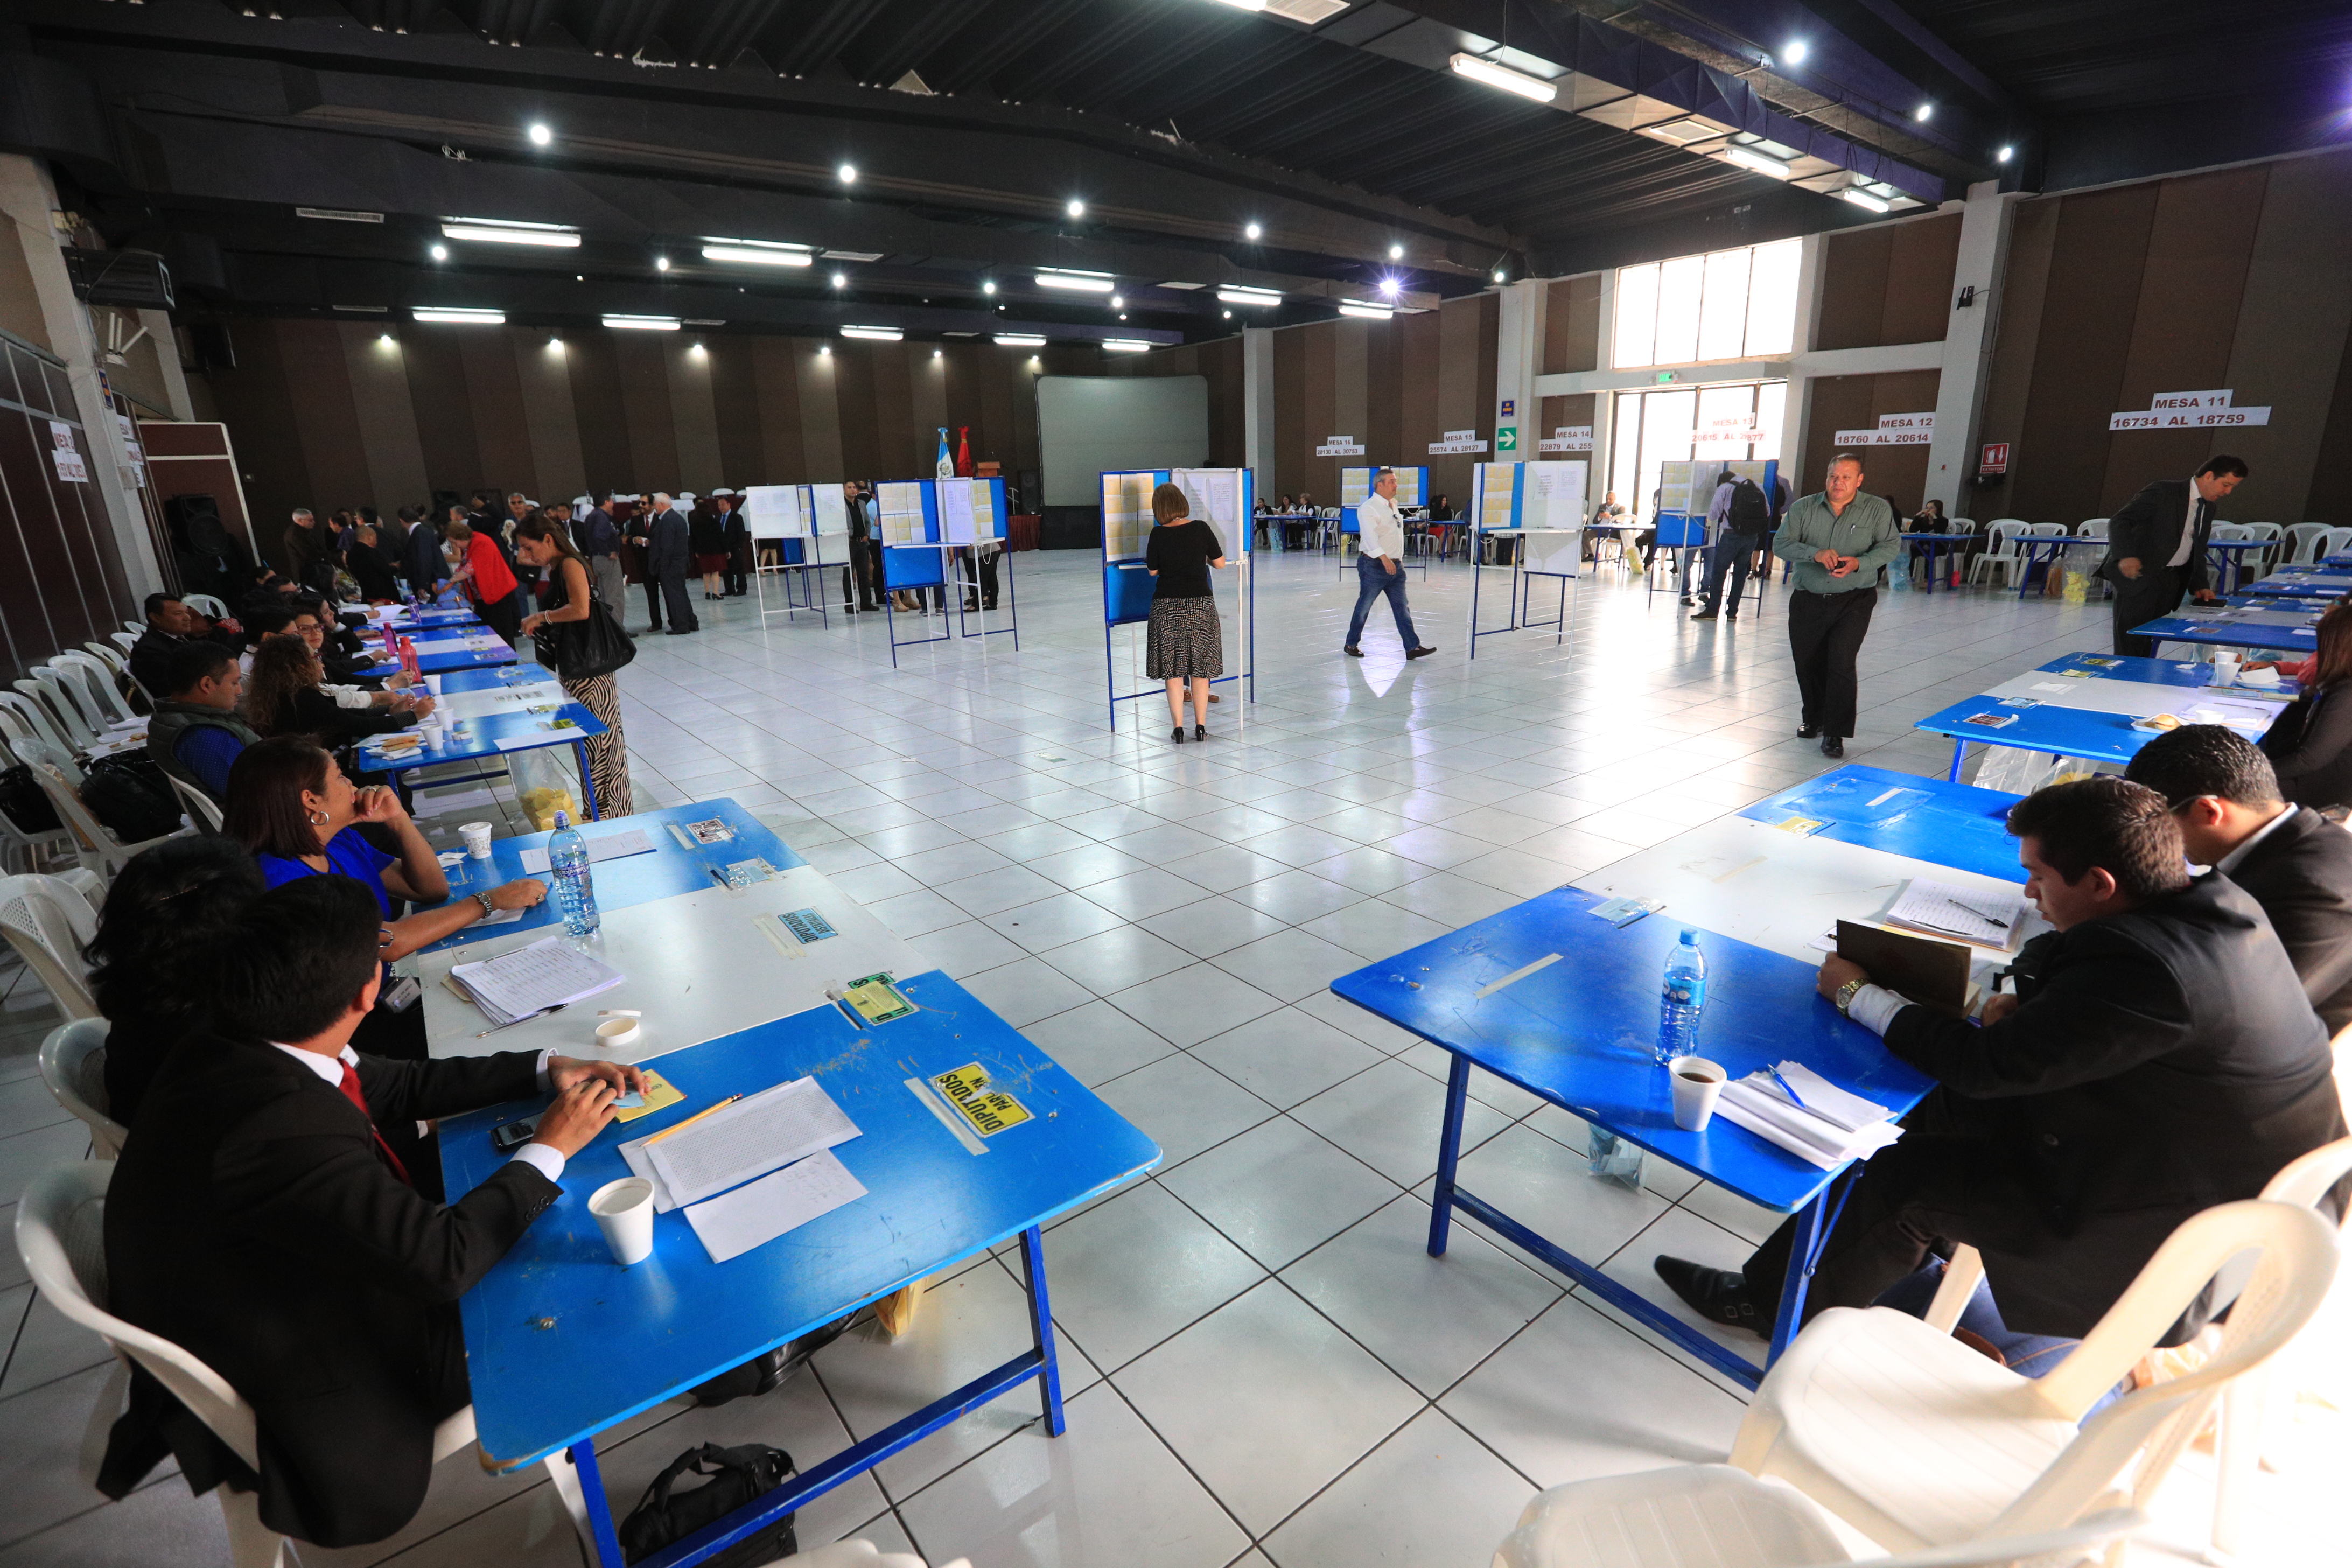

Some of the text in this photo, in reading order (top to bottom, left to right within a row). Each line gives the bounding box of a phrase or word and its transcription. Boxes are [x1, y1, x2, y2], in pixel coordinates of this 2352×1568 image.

[2154, 396, 2225, 408] MESA 11
[1712, 419, 1738, 427] MESA
[1881, 418, 1933, 428] MESA 12
[2113, 414, 2245, 428] 16734 AL 18759
[1692, 433, 1718, 442] 20615
[1837, 433, 1929, 444] 18760 AL 20614
[782, 913, 819, 943] DIPUTADOS
[941, 1074, 1005, 1132] DIPUTADOS
